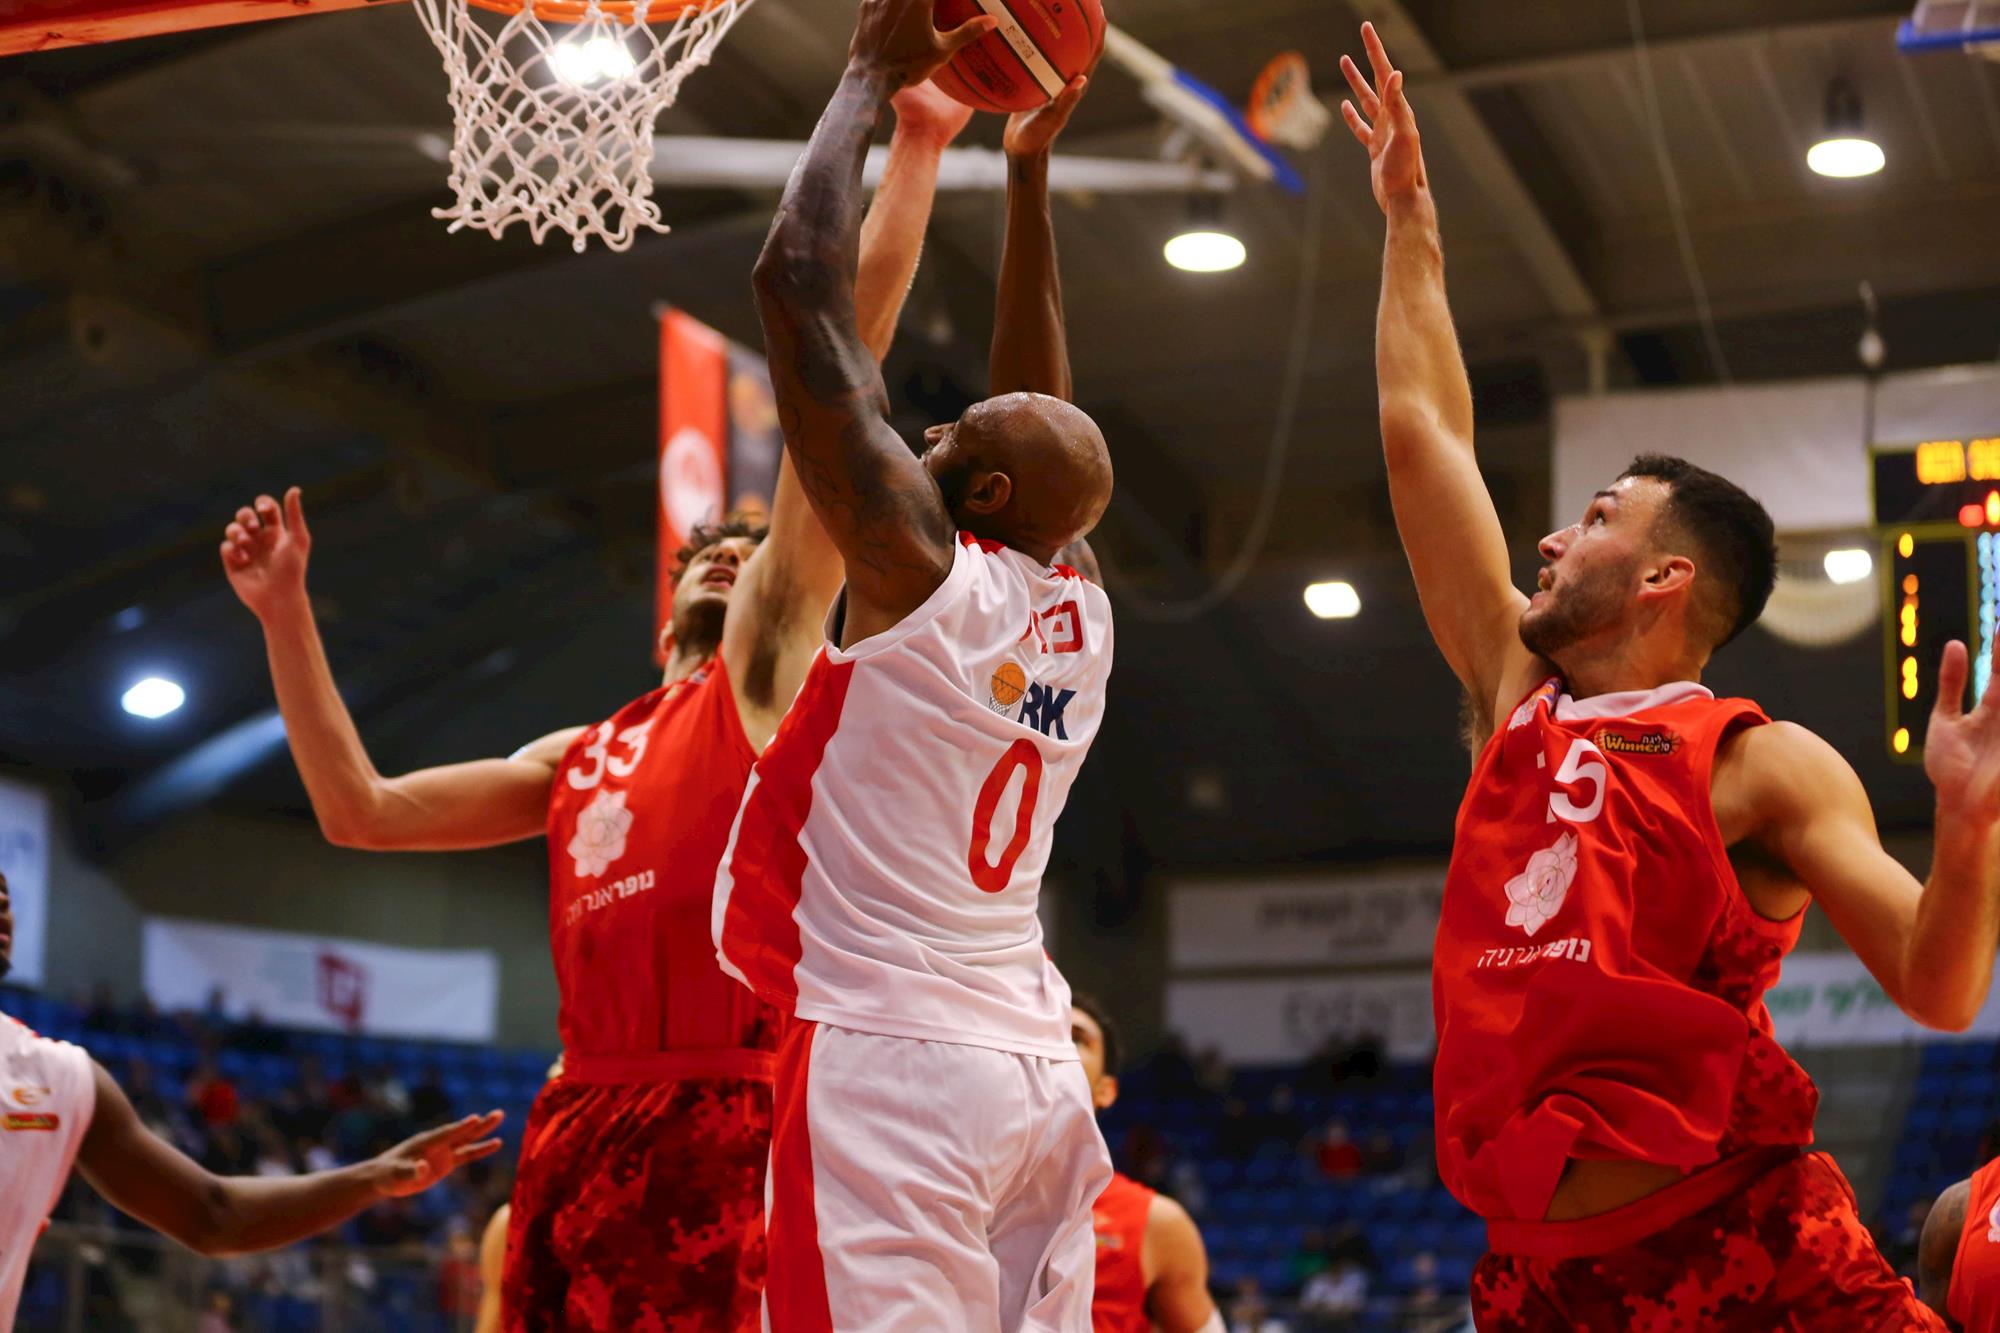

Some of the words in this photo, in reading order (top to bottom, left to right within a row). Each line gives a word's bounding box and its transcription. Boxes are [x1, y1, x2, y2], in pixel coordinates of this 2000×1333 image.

[567, 717, 656, 790] 33
[1537, 738, 1607, 823] 5
[1606, 736, 1660, 752] Winner
[967, 738, 1041, 893] 0
